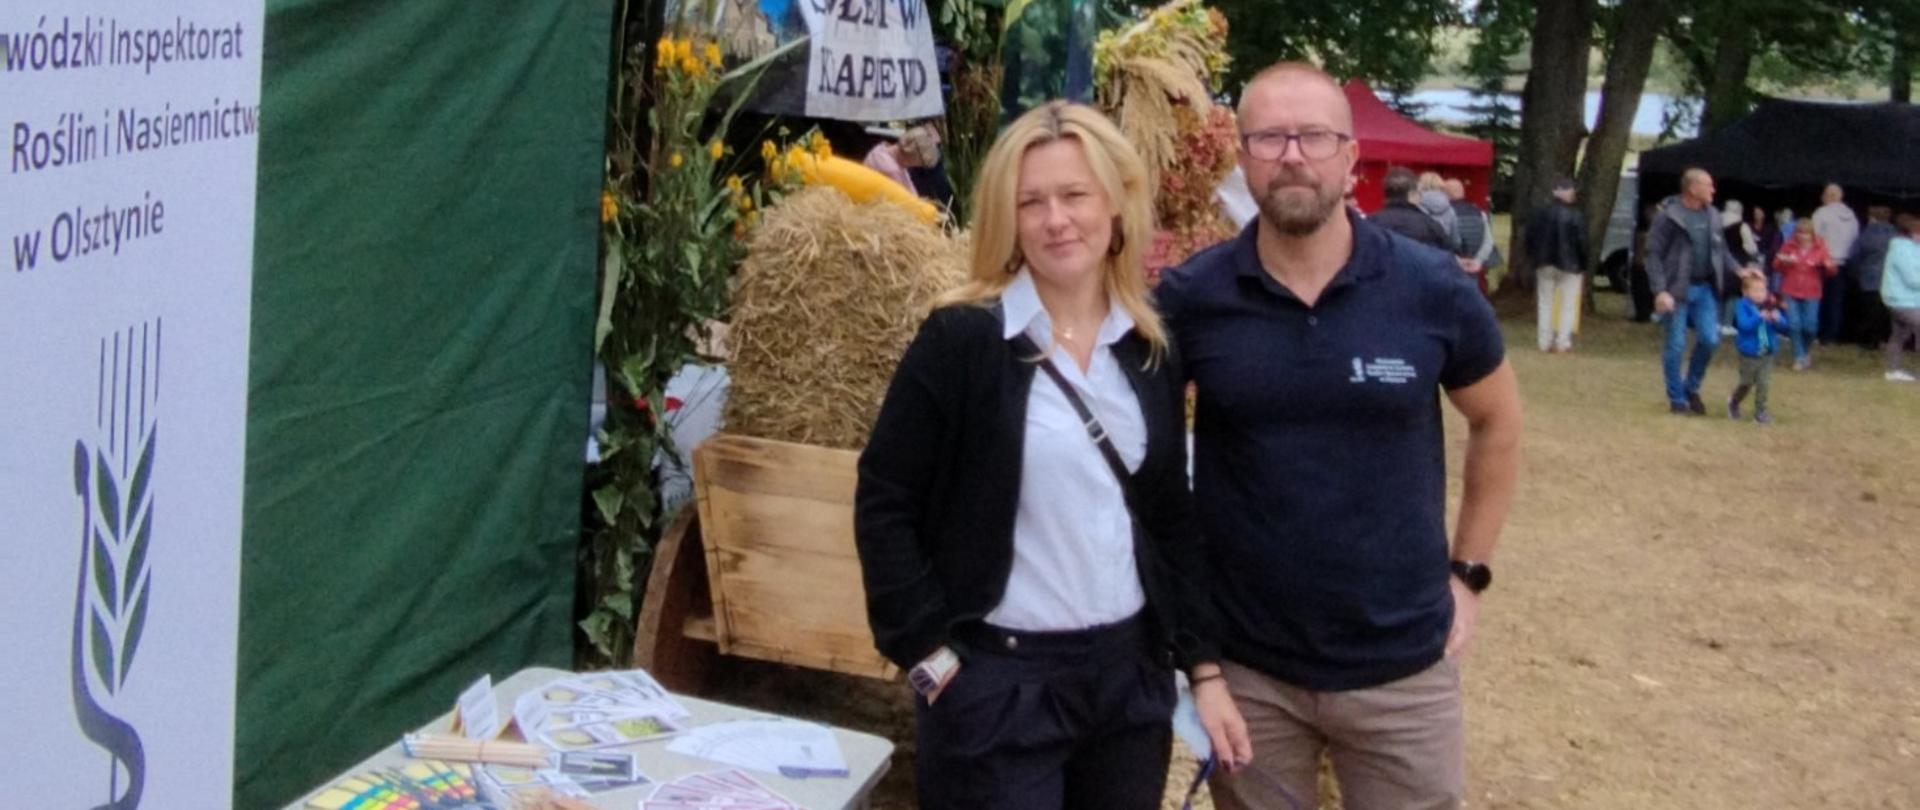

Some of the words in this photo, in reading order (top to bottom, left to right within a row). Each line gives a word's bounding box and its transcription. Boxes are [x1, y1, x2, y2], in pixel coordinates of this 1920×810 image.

[0, 15, 103, 72] wódzki
[109, 16, 243, 75] Inspektorat
[12, 112, 97, 174] Roślin
[103, 108, 110, 157] i
[13, 230, 41, 272] w
[50, 191, 164, 262] Olsztynie
